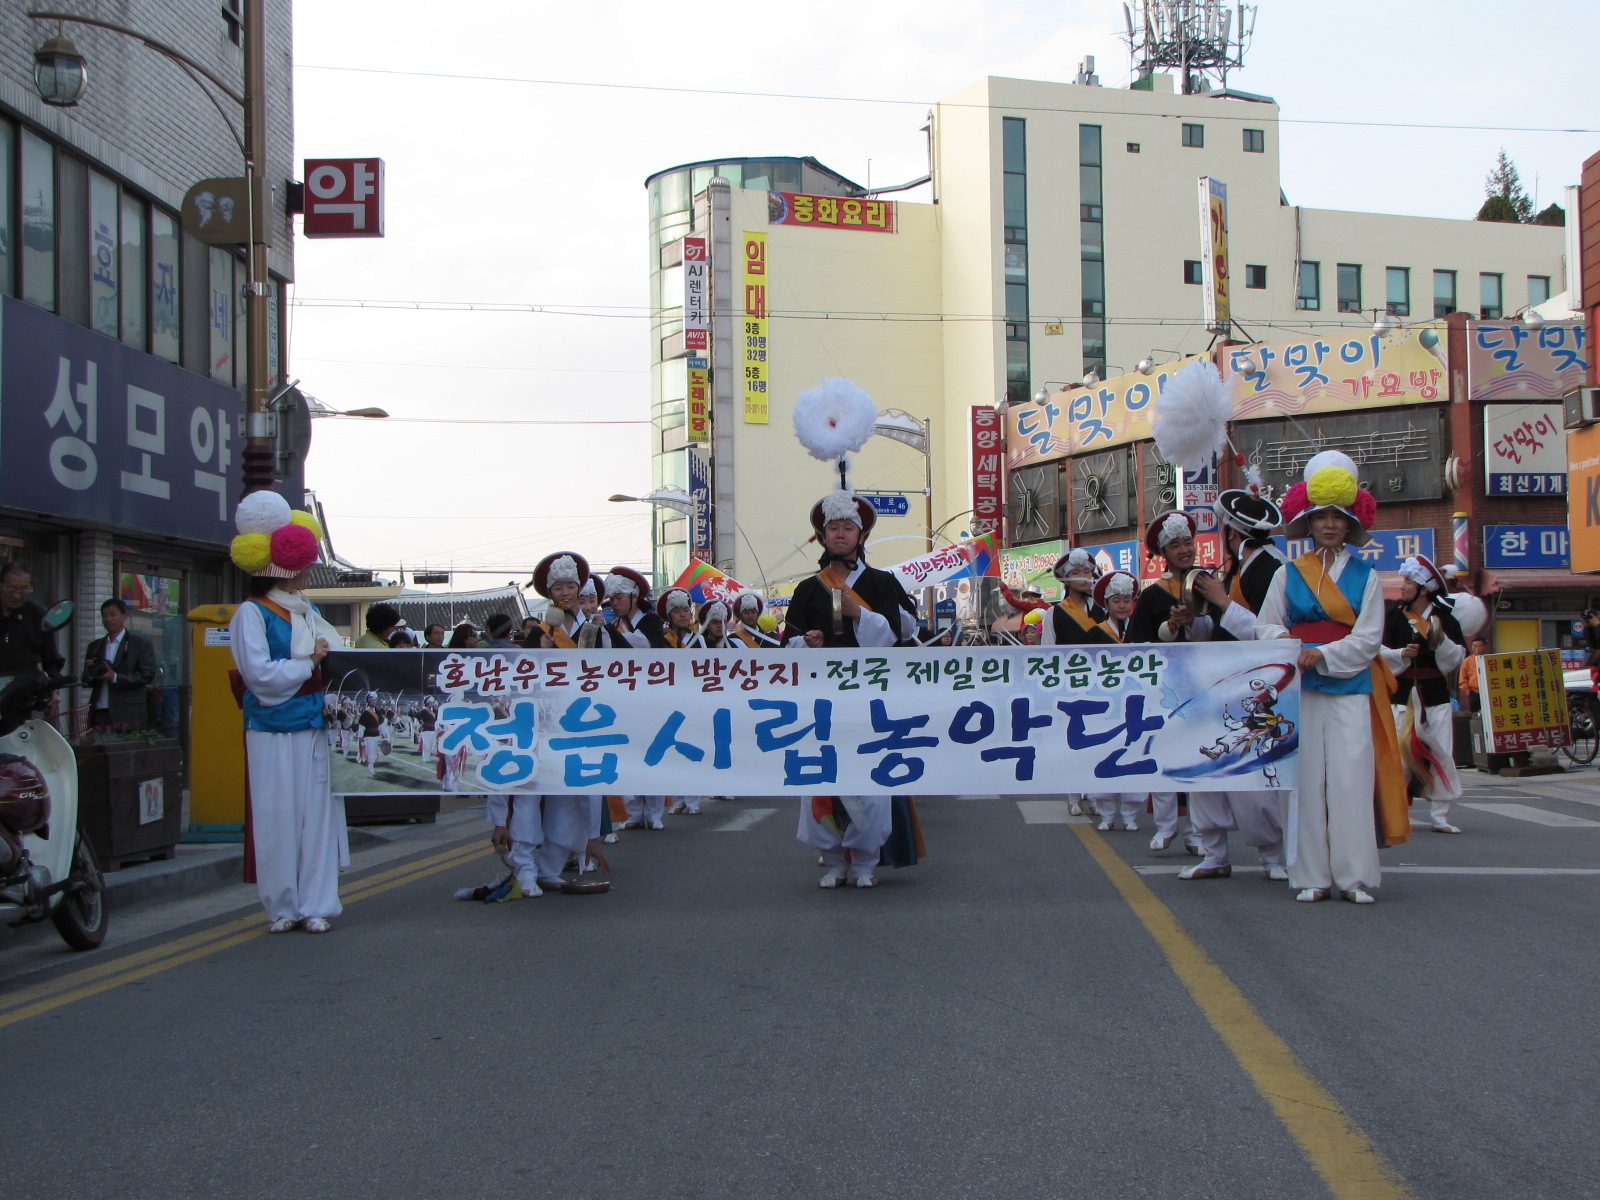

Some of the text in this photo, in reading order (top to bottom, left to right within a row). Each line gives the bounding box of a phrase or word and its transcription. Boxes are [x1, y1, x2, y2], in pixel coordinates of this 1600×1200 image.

[309, 163, 375, 229] 약
[794, 195, 887, 228] 중화요리
[745, 240, 766, 319] 임대
[687, 331, 706, 339] AVIS
[745, 323, 760, 335] 3층
[746, 336, 767, 349] 30평
[746, 350, 767, 362] 32평
[1231, 335, 1381, 392] 달맞이
[745, 367, 760, 379] 5층
[747, 381, 767, 393] 16평
[1342, 368, 1441, 400] 가요방
[691, 371, 706, 431] 노래마당
[44, 356, 283, 522] 성모약
[1493, 413, 1558, 464] 달맞이
[975, 408, 999, 533] 동양세탁공장
[1500, 475, 1567, 494] 최신기계
[873, 497, 906, 510] 덕로 46
[1185, 492, 1218, 505] 슈퍼
[900, 553, 961, 582] 전야제
[444, 653, 1164, 693] 호남우도농악의 발상지 전국 제일의 정읍농악
[441, 696, 1164, 788] 정읍시립농악단
[1504, 729, 1566, 750] 전주식당
